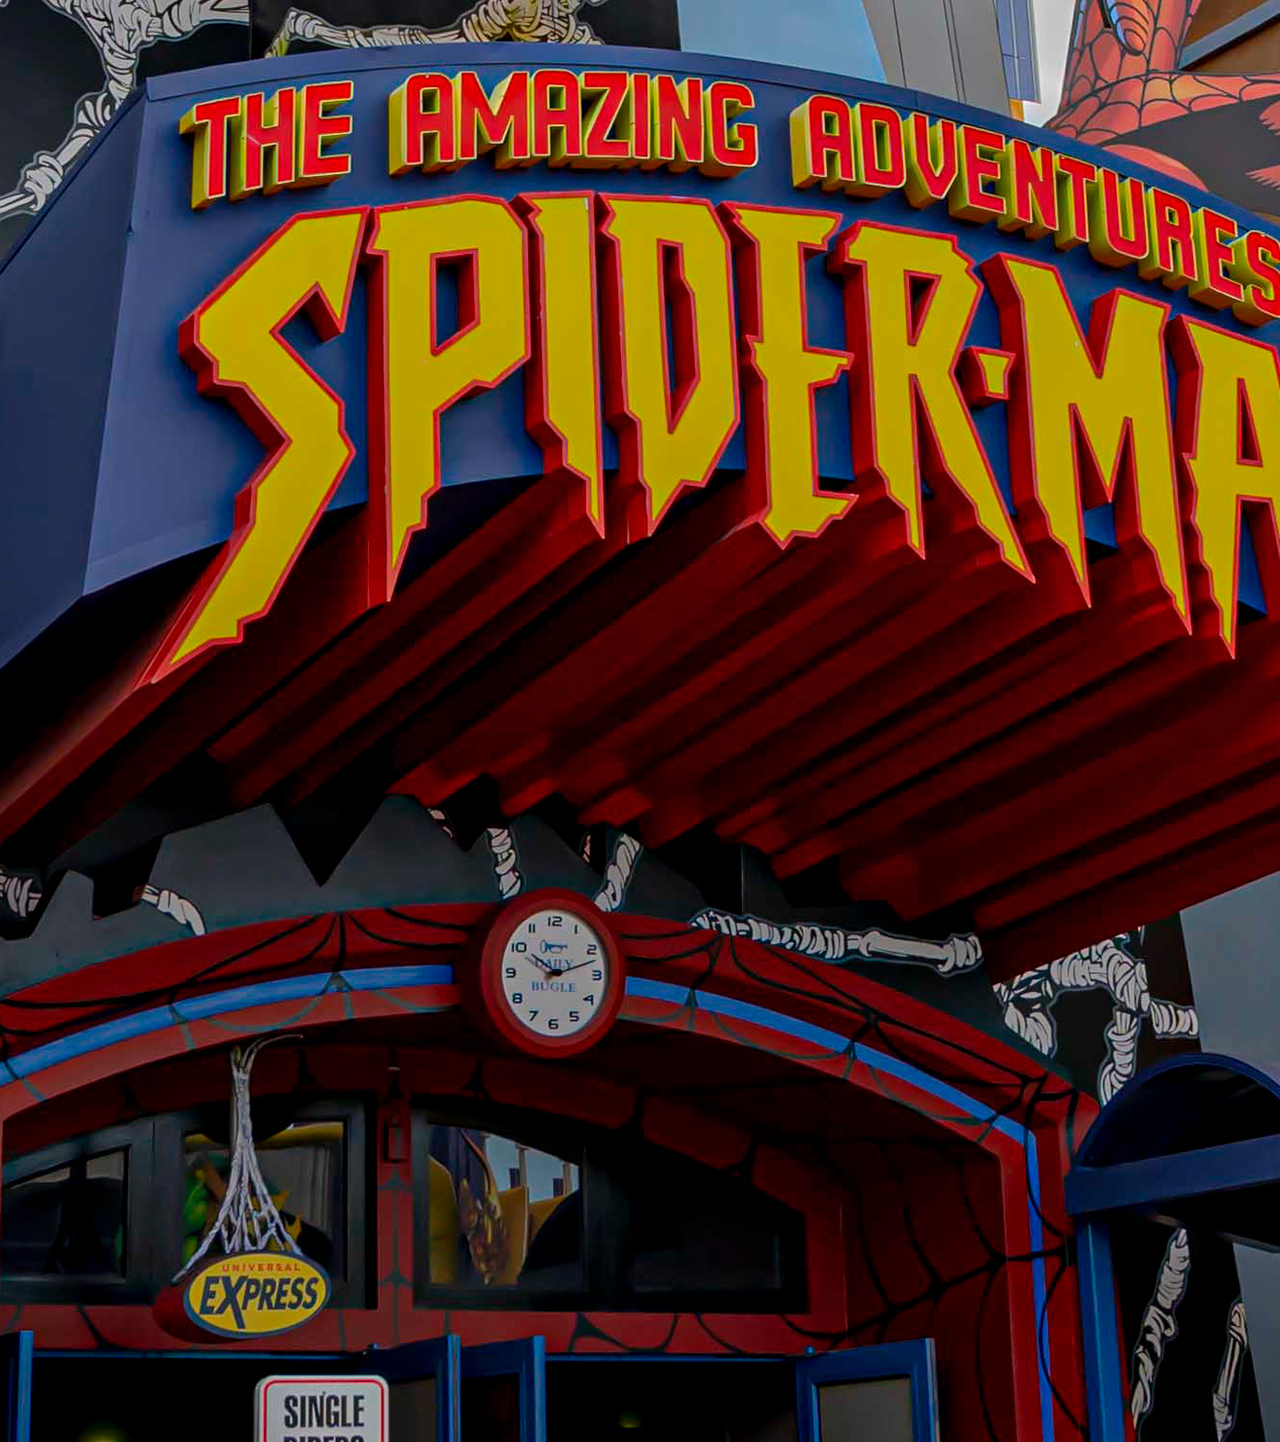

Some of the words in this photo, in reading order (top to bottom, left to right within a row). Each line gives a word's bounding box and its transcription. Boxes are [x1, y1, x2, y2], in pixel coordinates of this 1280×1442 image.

[180, 78, 354, 210] THE
[388, 68, 759, 178] AMAZING
[547, 916, 563, 927] 12
[528, 923, 536, 933] 11
[511, 942, 527, 953] 10
[586, 944, 598, 955] 2
[505, 967, 517, 978] 9
[592, 970, 602, 981] 3
[531, 980, 577, 993] BUGLE
[512, 992, 523, 1004] 8
[583, 994, 594, 1006] 4
[529, 1010, 539, 1021] 7
[569, 1011, 580, 1022] 5
[548, 1019, 559, 1030] 6
[221, 1262, 301, 1273] UNIVERSAL
[200, 1275, 320, 1329] EXPRESS
[283, 1394, 366, 1429] SINGLE
